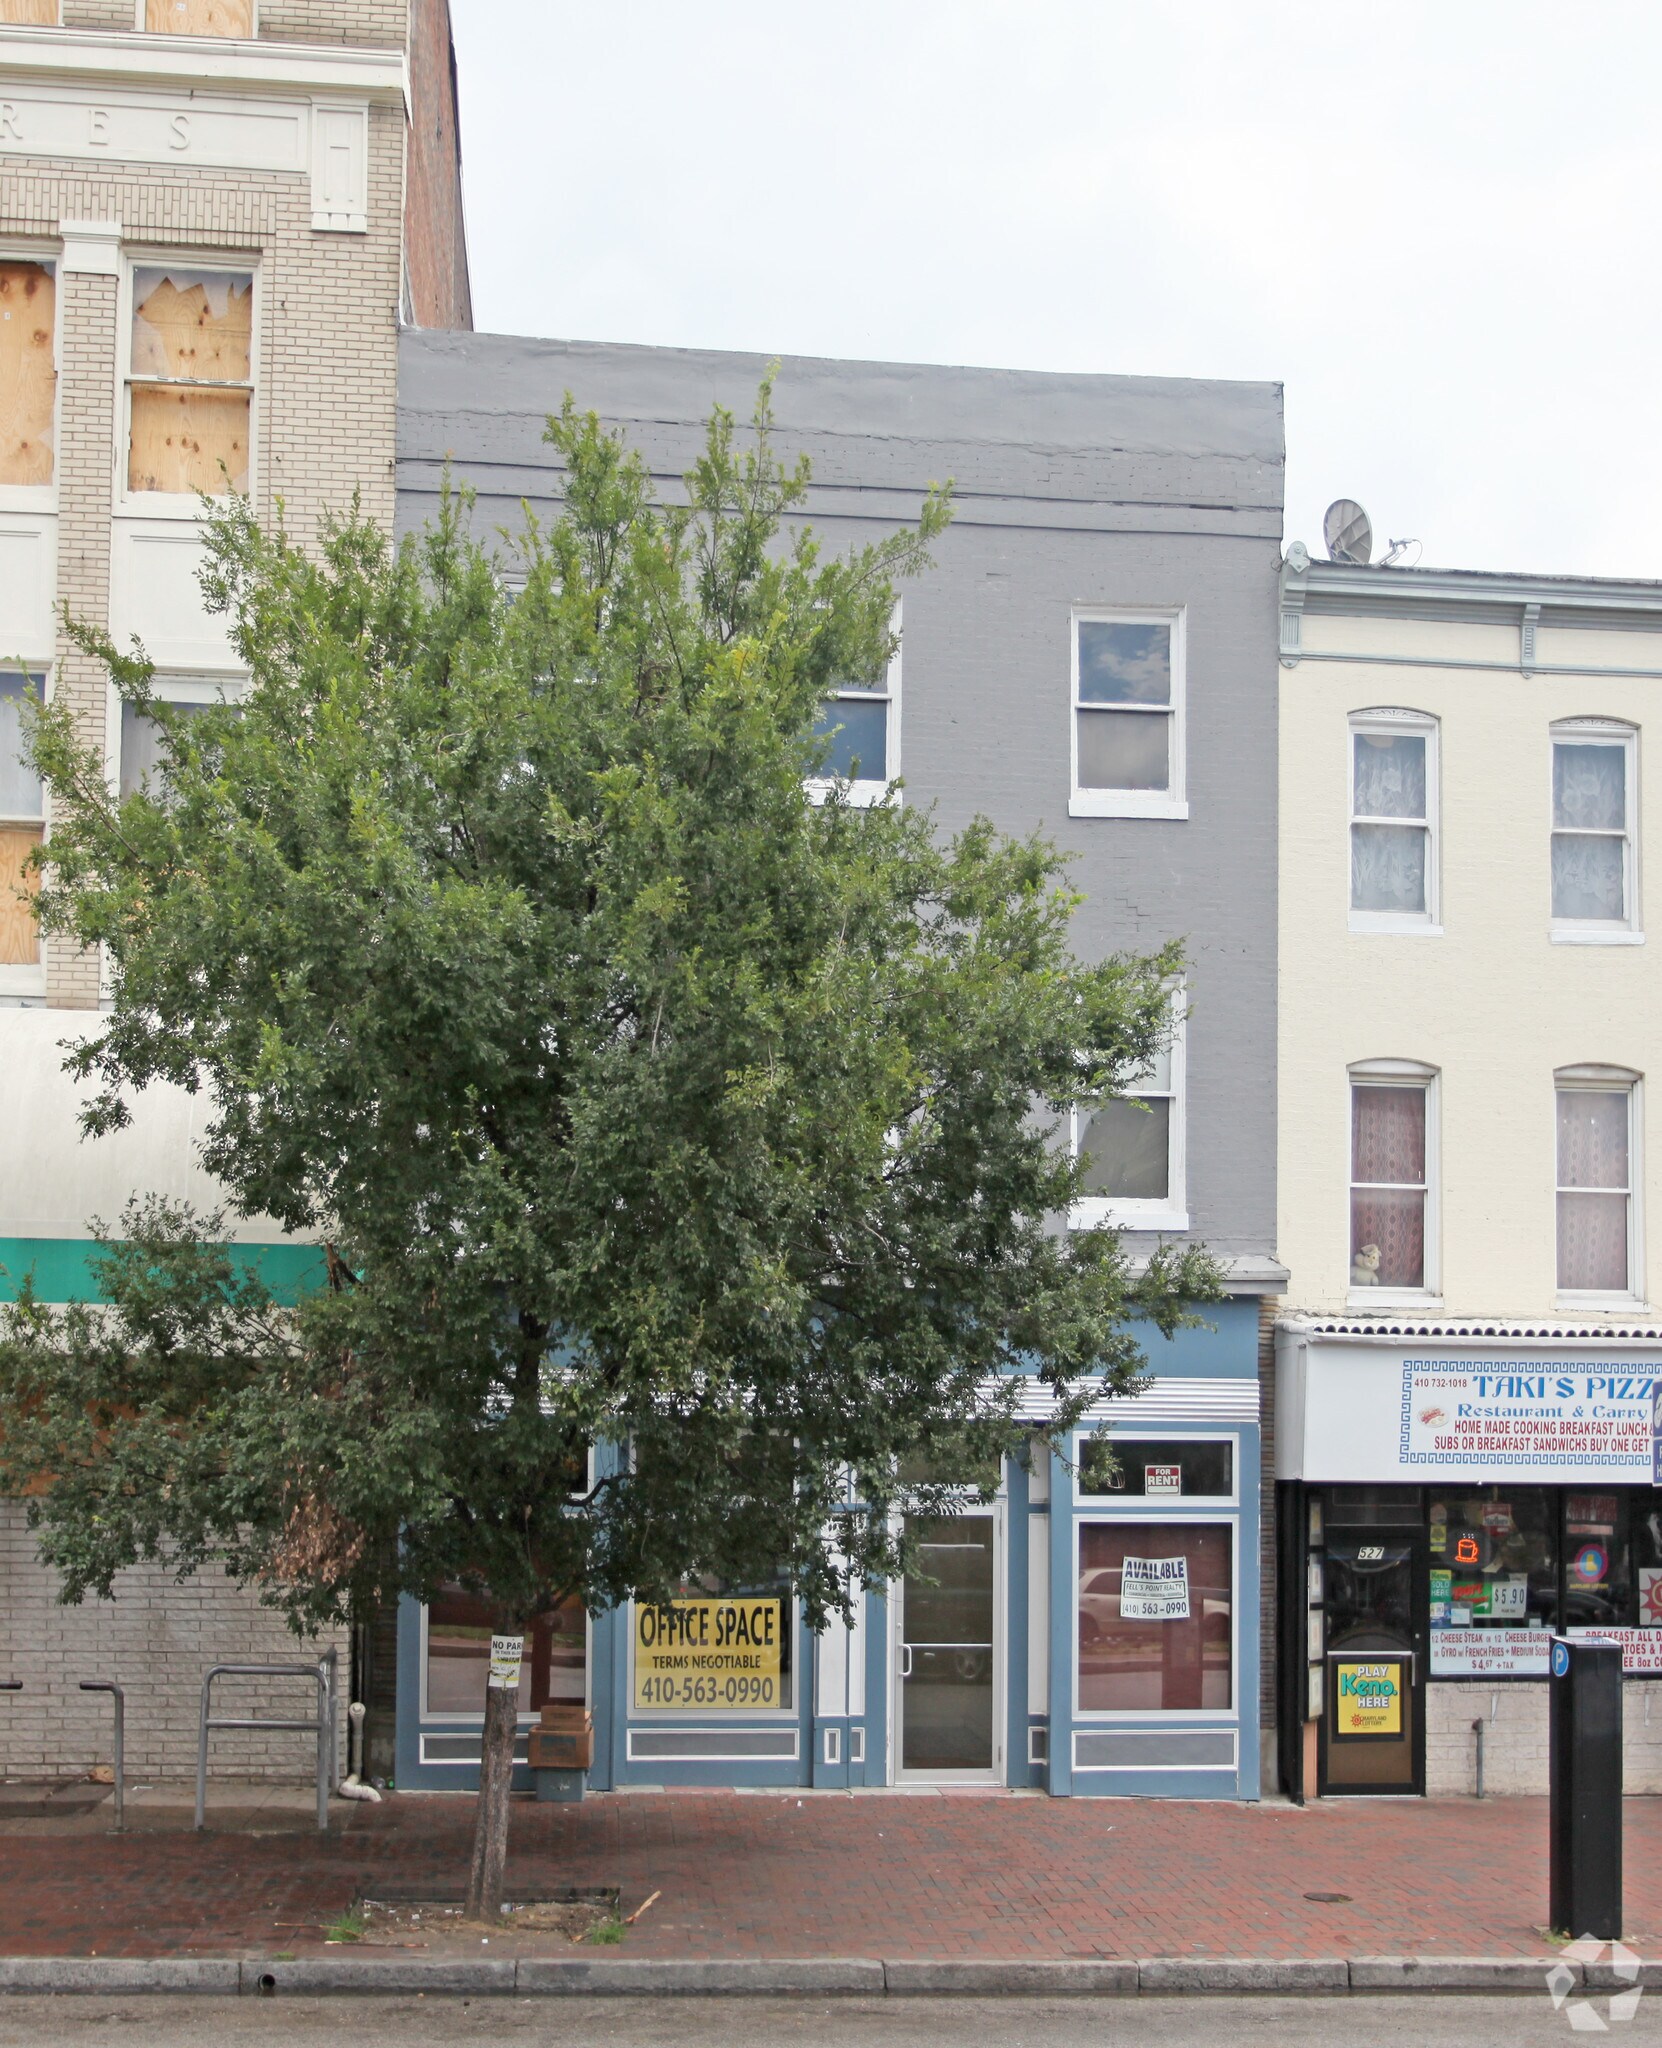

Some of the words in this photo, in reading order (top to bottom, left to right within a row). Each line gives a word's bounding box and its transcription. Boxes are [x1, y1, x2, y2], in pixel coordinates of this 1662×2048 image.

[1414, 1378, 1429, 1388] 410
[1431, 1378, 1468, 1388] 732-1018
[1472, 1375, 1575, 1399] TAKI'S
[1586, 1376, 1653, 1400] PIZZ
[1458, 1403, 1564, 1418] Restaurant
[1572, 1405, 1584, 1418] &
[1592, 1405, 1648, 1421] Carry
[1454, 1420, 1482, 1434] HOME
[1484, 1420, 1511, 1434] MADE
[1513, 1421, 1557, 1435] COOKING
[1559, 1421, 1614, 1436] BREAKFAST
[1616, 1422, 1648, 1436] LUNCH
[1434, 1435, 1459, 1450] SUBS
[1461, 1436, 1475, 1450] OR
[1477, 1437, 1531, 1451] BREAKFAST
[1533, 1437, 1588, 1452] SANDWICHS
[1590, 1438, 1609, 1452] BUY
[1610, 1438, 1629, 1452] ONE
[1631, 1438, 1650, 1452] GET
[1155, 1468, 1171, 1476] FOR
[1147, 1475, 1179, 1486] RENT
[1359, 1547, 1384, 1558] 527
[1125, 1560, 1185, 1580] AVAILABLE
[1145, 1584, 1163, 1592] POINT
[1164, 1583, 1183, 1591] REALTY
[1431, 1580, 1450, 1589] SOLD
[1431, 1589, 1450, 1598] HERE
[1122, 1603, 1139, 1615] (410)
[640, 1606, 709, 1647] OFFICE
[715, 1606, 774, 1647] SPACE
[1440, 1632, 1463, 1643] CHEESE
[1464, 1632, 1483, 1643] STEAK
[1504, 1631, 1528, 1643] CHEESE
[1637, 1630, 1652, 1642] ALL
[1656, 1630, 1662, 1642] D
[492, 1640, 504, 1650] NO
[506, 1641, 522, 1650] PAR
[1440, 1646, 1457, 1657] GYRO
[1465, 1645, 1488, 1657] FRENCH
[1488, 1645, 1504, 1657] FRIES
[1510, 1645, 1534, 1657] MEDIUM
[1649, 1643, 1657, 1655] &
[652, 1655, 689, 1669] TERMS
[692, 1655, 761, 1669] NEGOTIABLE
[1502, 1661, 1514, 1670] TAX
[1555, 1649, 1564, 1670] P
[1637, 1656, 1651, 1668] 8oz
[1357, 1665, 1388, 1678] PLAY
[641, 1677, 774, 1703] 410-563-0990
[1357, 1696, 1390, 1709] HERE
